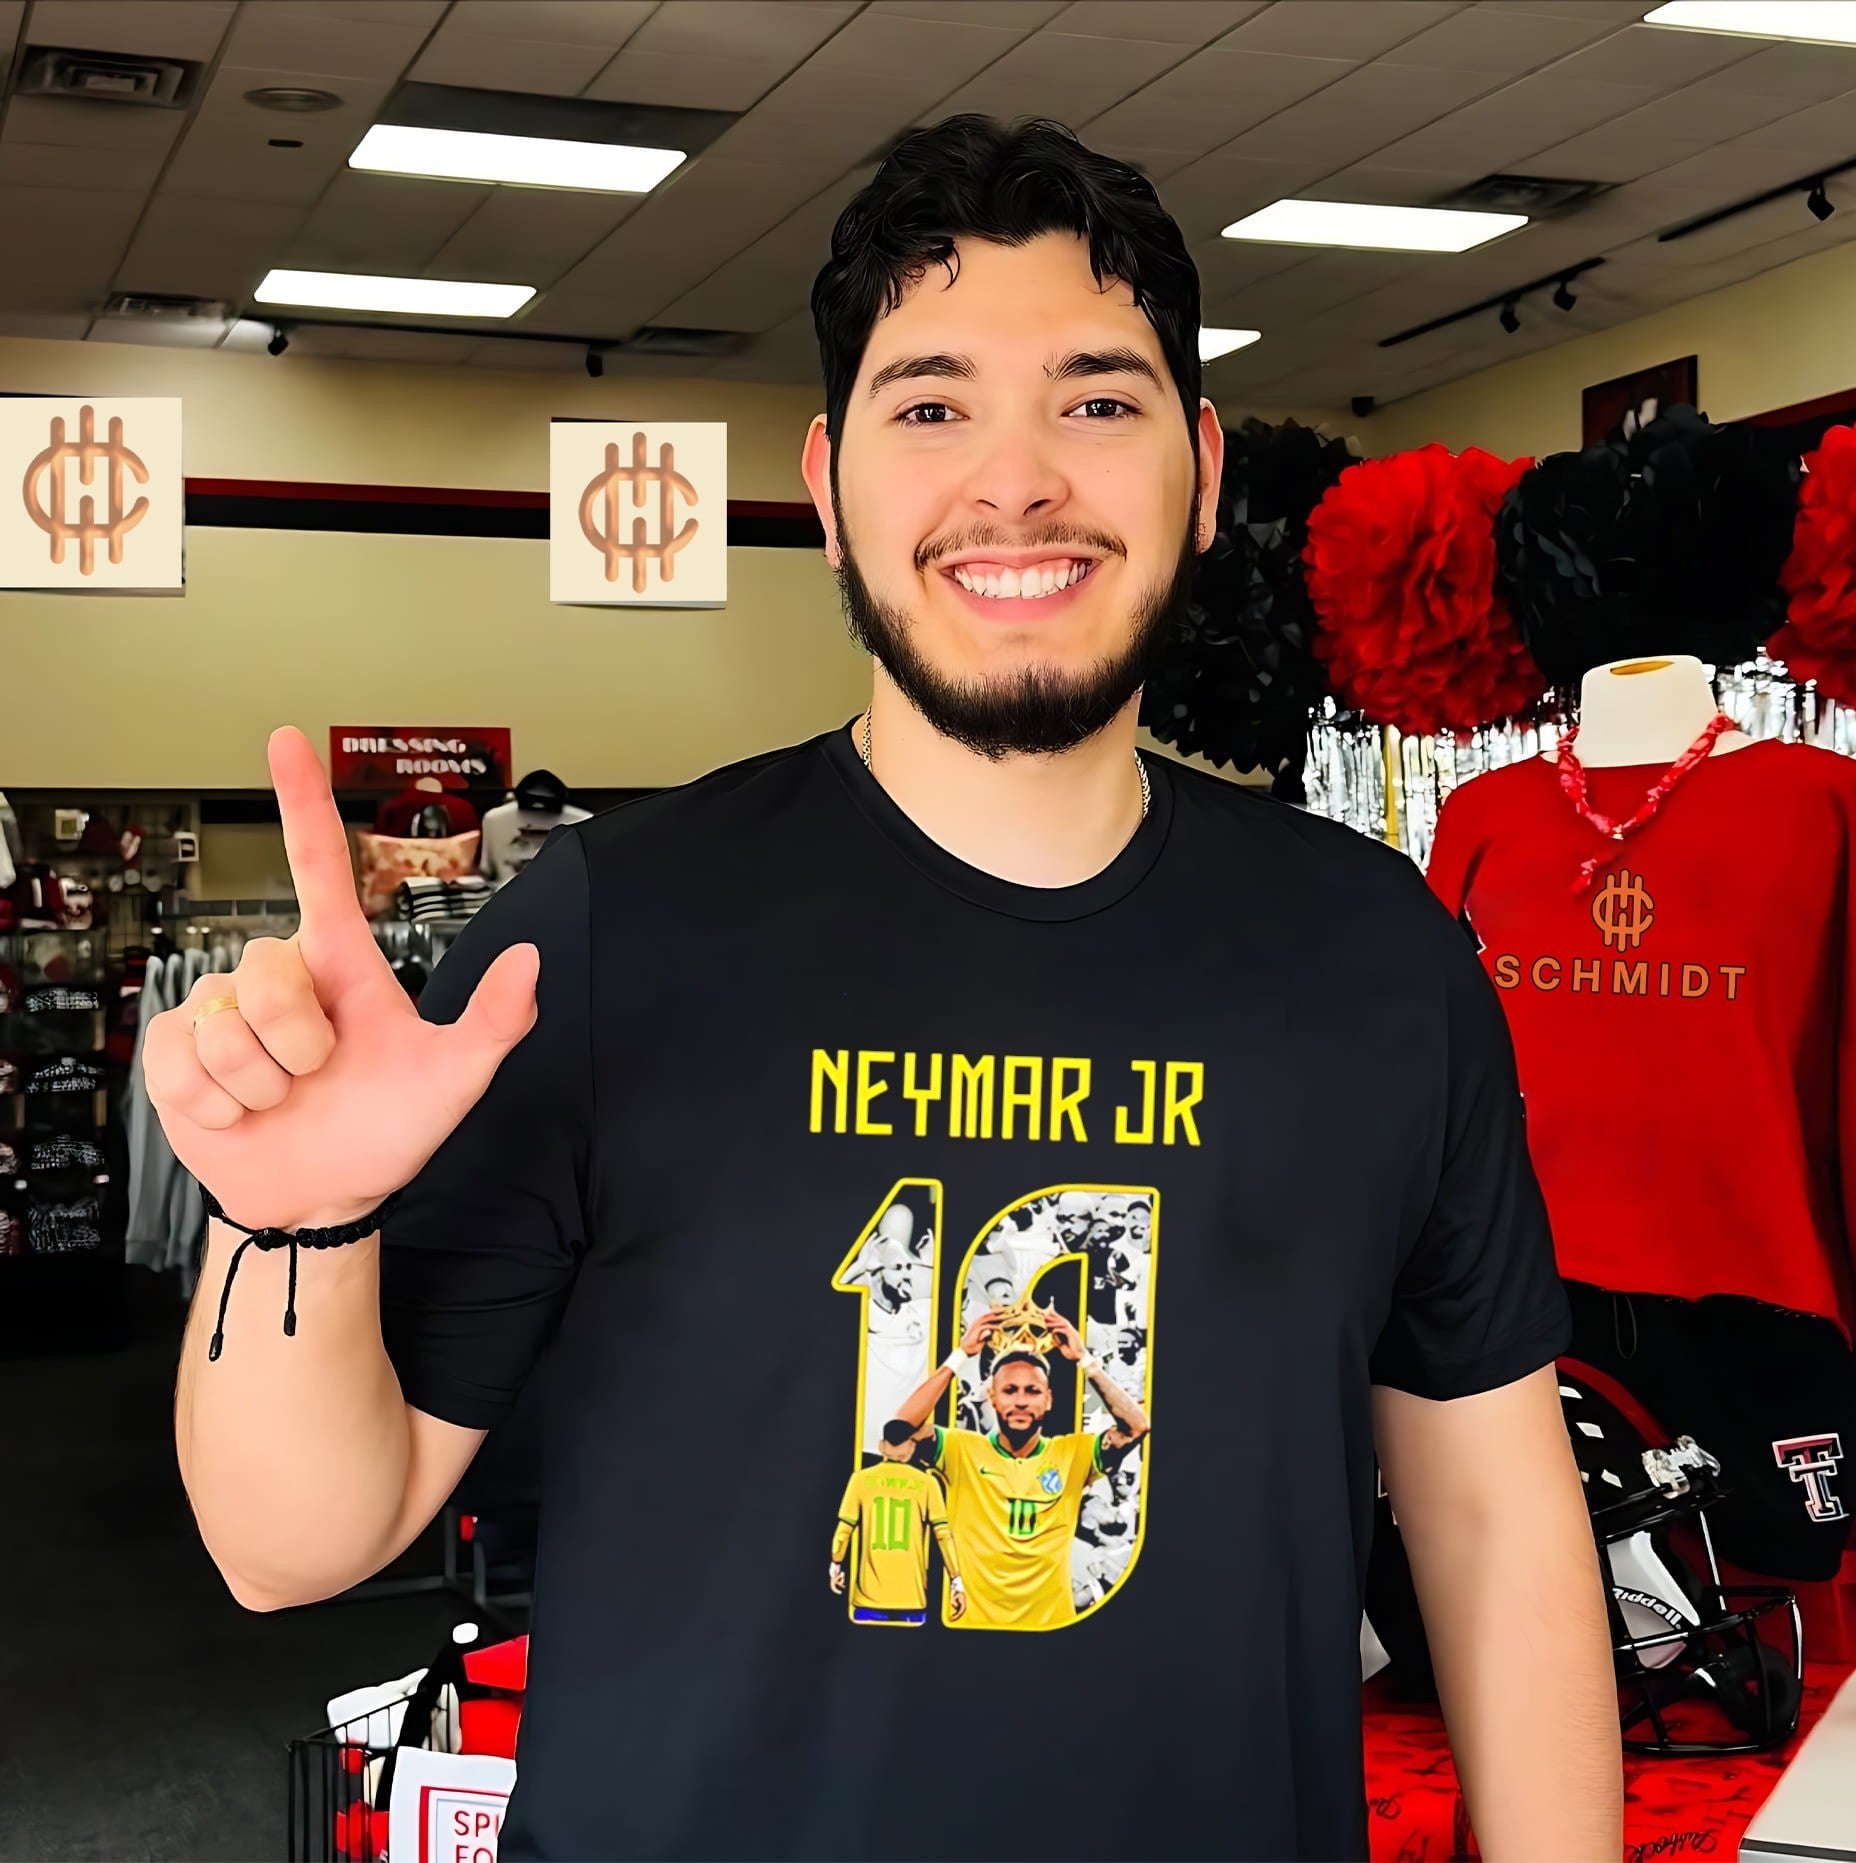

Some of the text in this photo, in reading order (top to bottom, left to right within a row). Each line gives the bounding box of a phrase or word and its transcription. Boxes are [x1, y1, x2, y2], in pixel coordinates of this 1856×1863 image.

[396, 758, 487, 776] ROOMS
[1494, 953, 1747, 1000] SCHMIDT
[809, 1048, 1205, 1147] NEYMAR JR
[872, 1496, 911, 1552] 10
